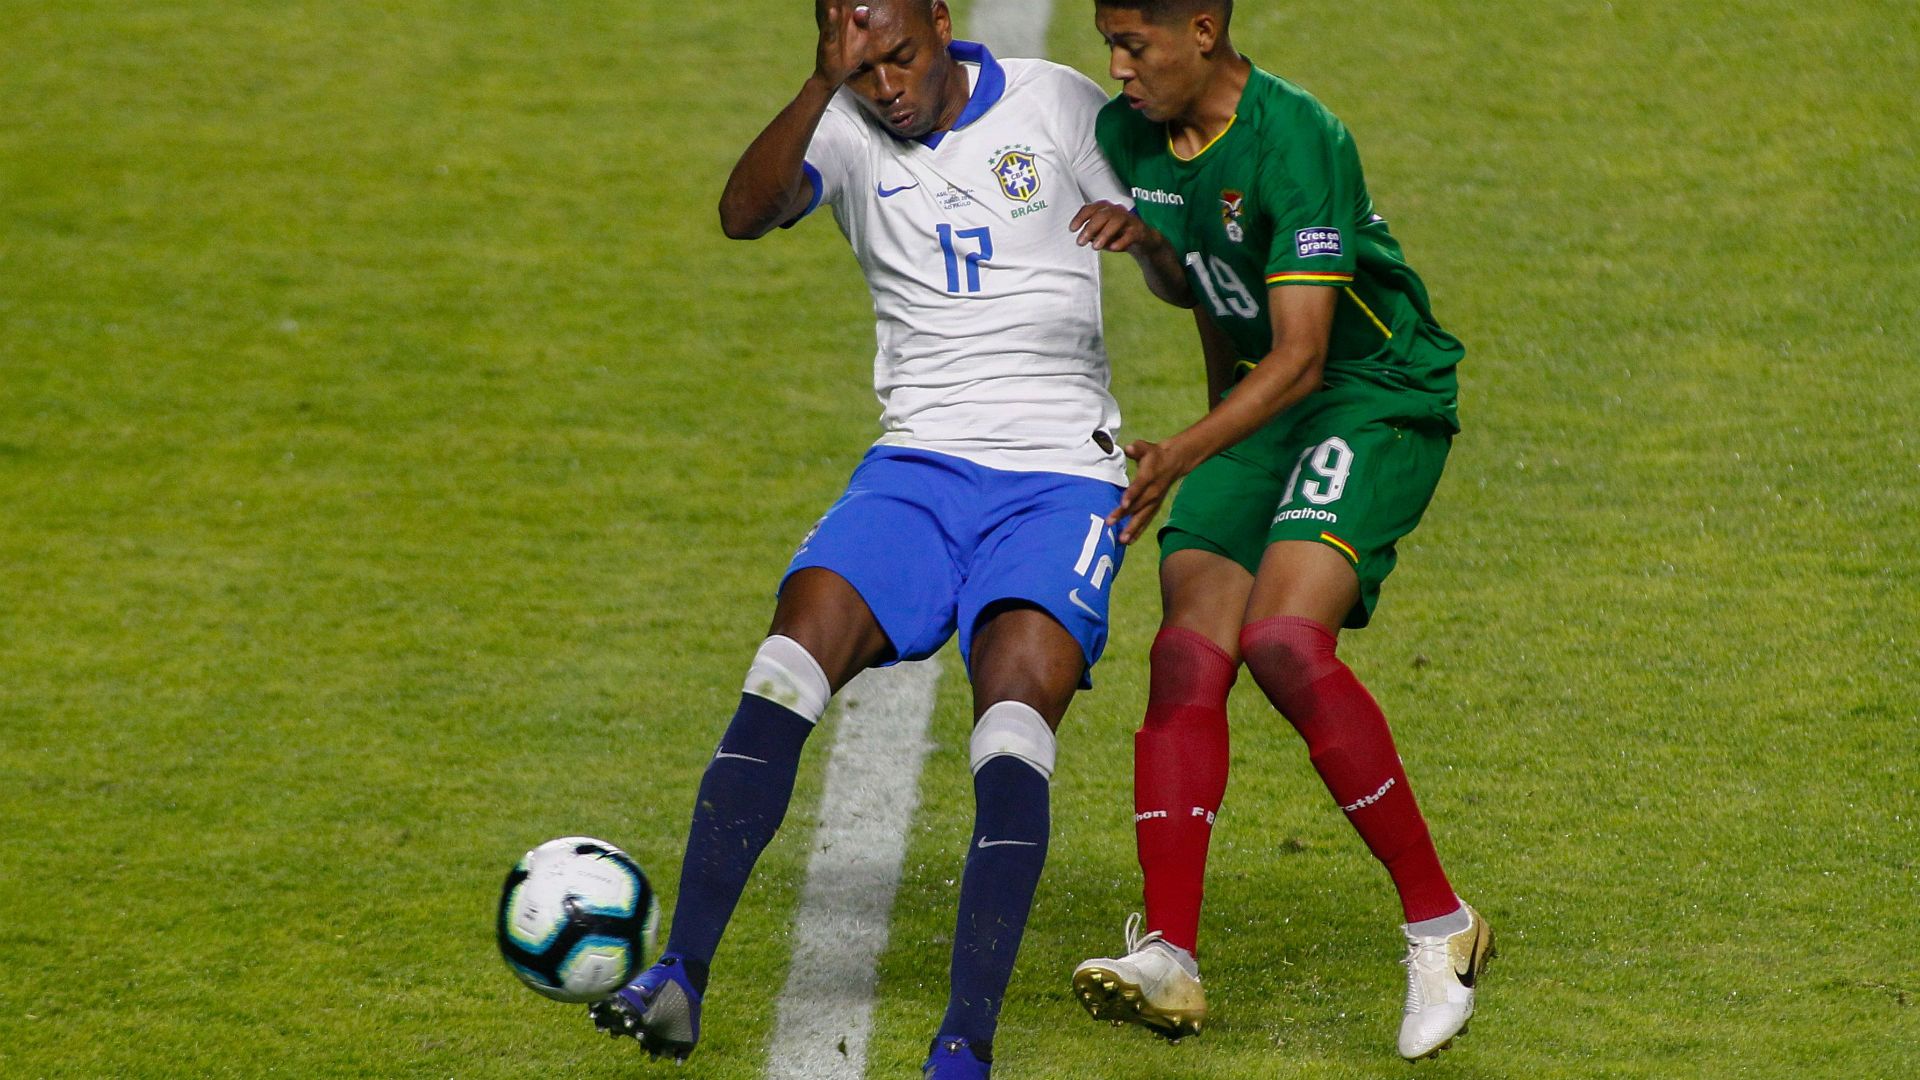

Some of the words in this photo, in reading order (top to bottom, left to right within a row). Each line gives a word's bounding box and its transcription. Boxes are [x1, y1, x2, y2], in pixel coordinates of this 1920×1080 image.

[1131, 186, 1184, 205] maathon
[1010, 199, 1049, 219] BRASIL
[1299, 231, 1326, 242] Cree
[1327, 232, 1339, 241] en
[1300, 239, 1339, 255] grande
[935, 223, 994, 293] 17
[1185, 250, 1260, 319] 19
[1340, 777, 1396, 812] athon
